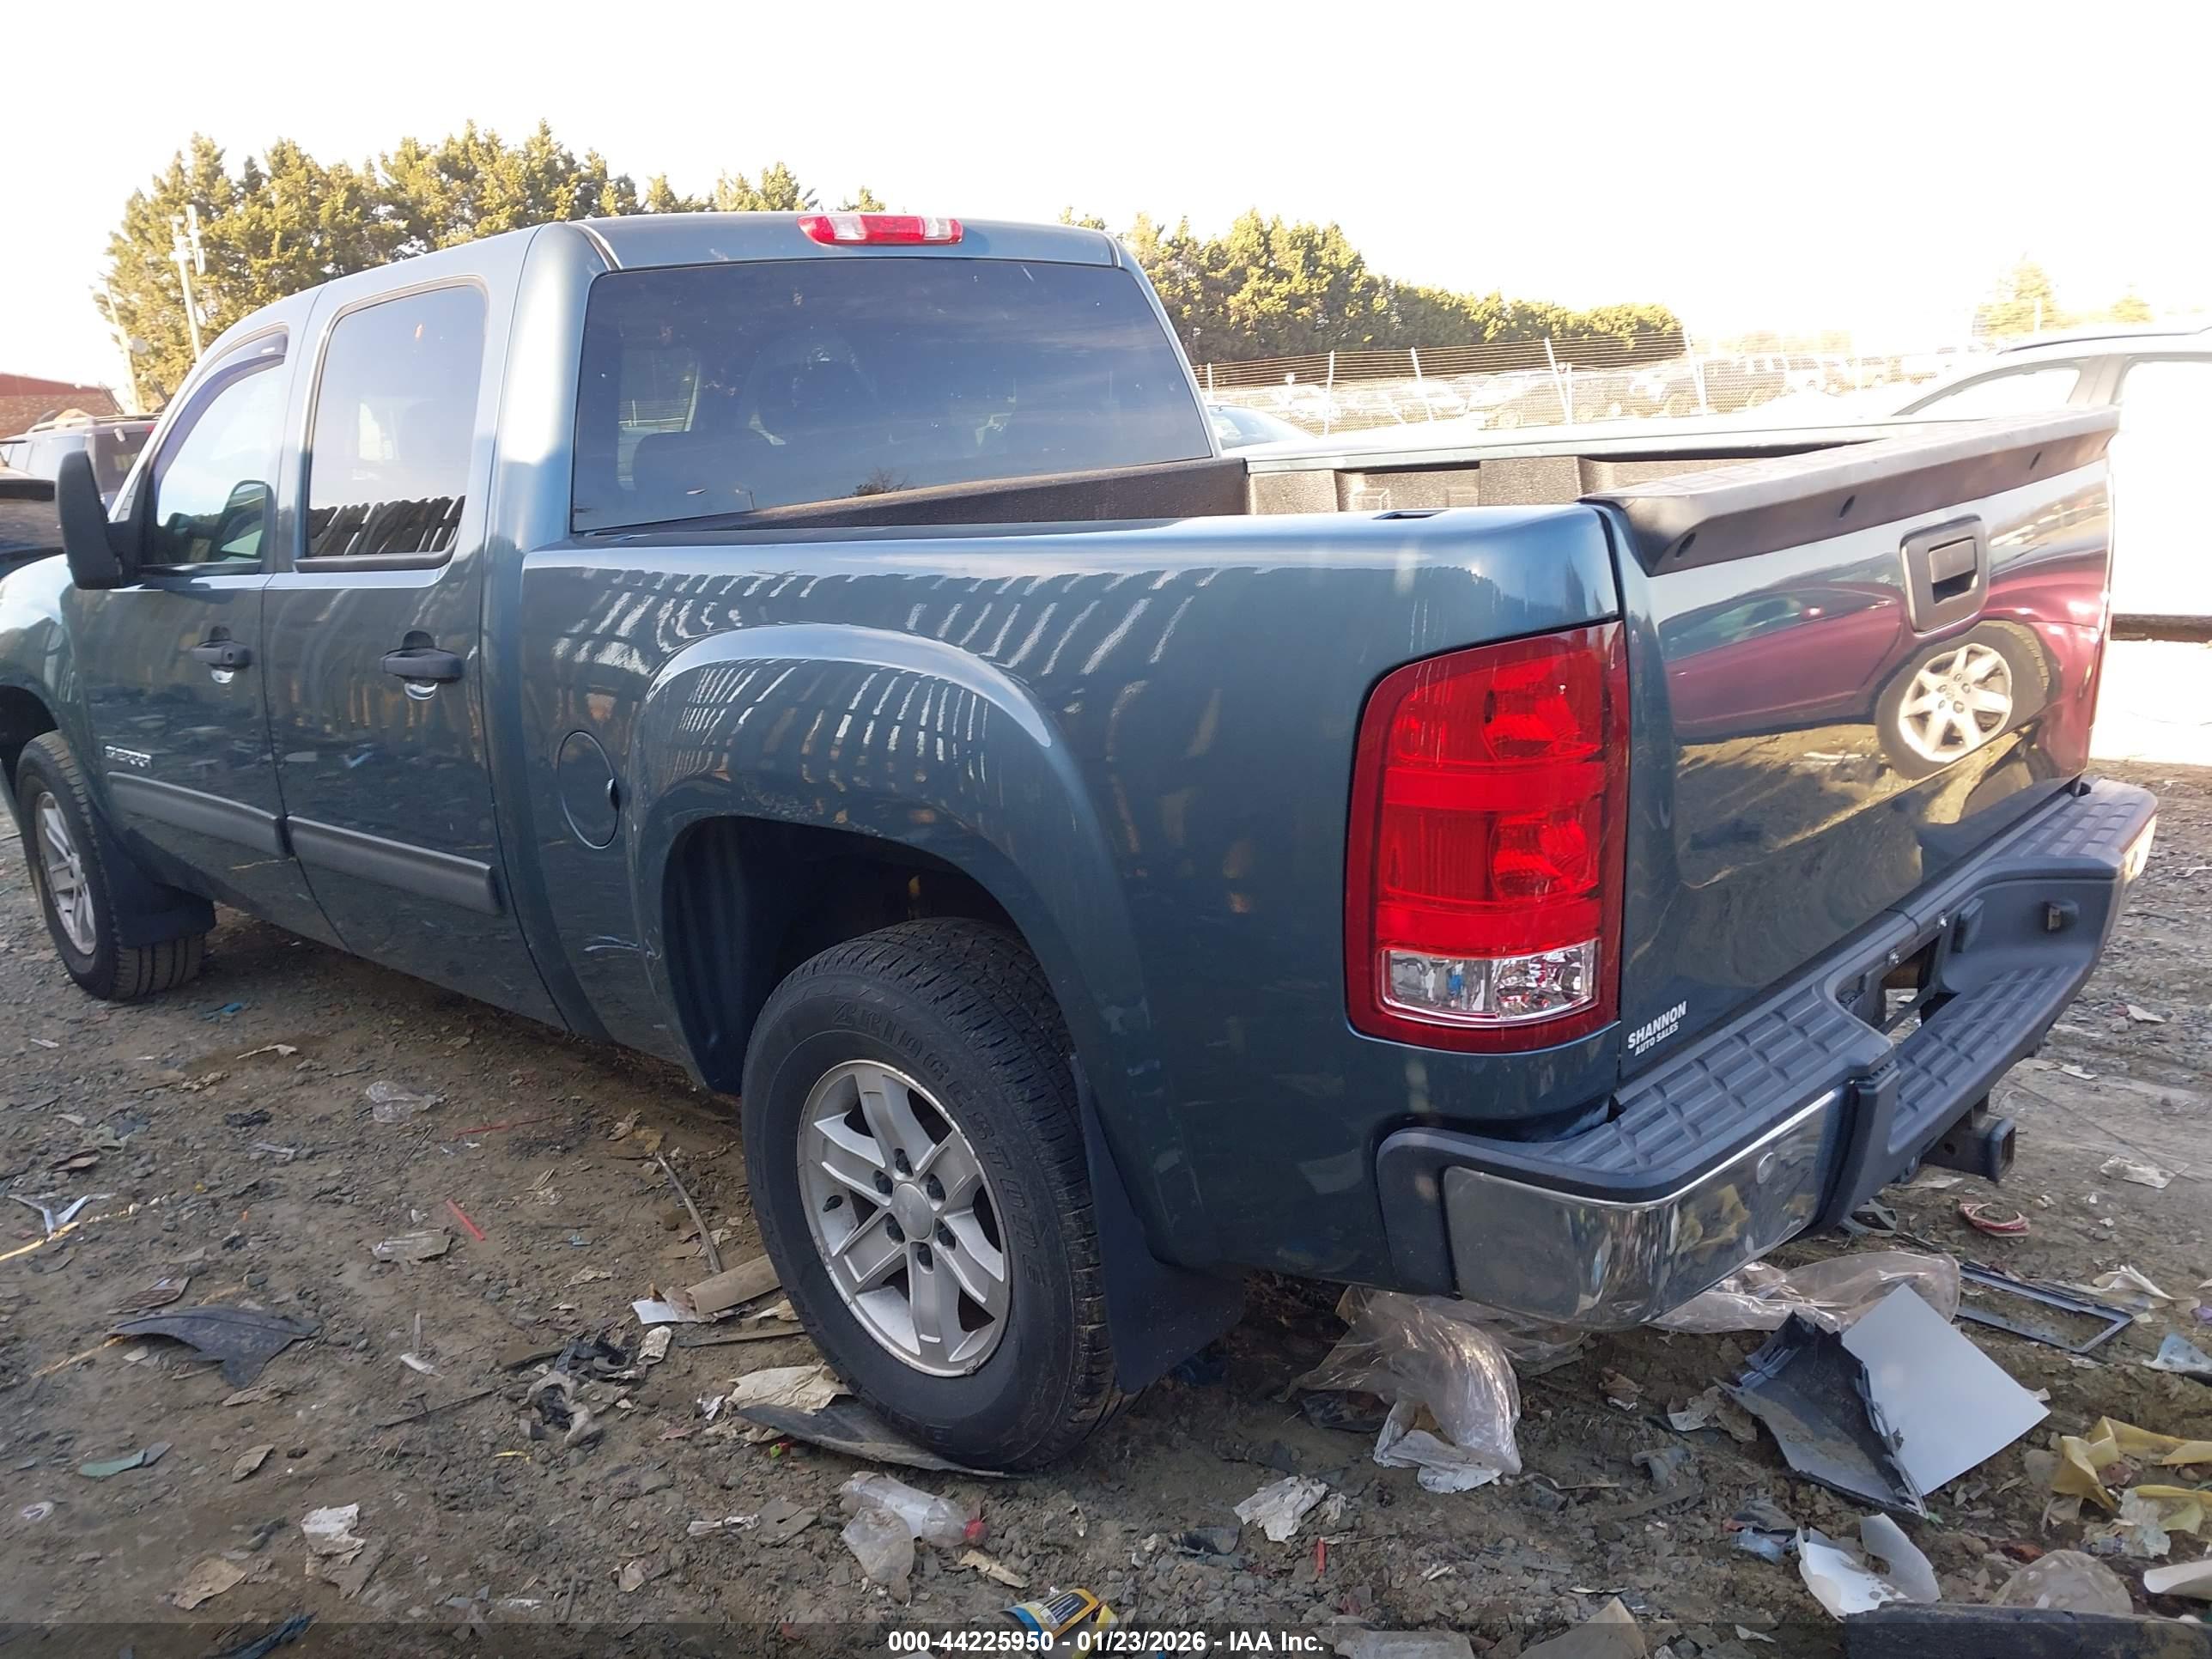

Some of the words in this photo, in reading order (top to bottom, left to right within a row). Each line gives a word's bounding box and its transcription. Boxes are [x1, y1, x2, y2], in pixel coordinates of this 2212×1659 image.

[1627, 1000, 1687, 1049] SHANNON
[1634, 1036, 1656, 1057] AUTO
[1656, 1022, 1679, 1042] SALES
